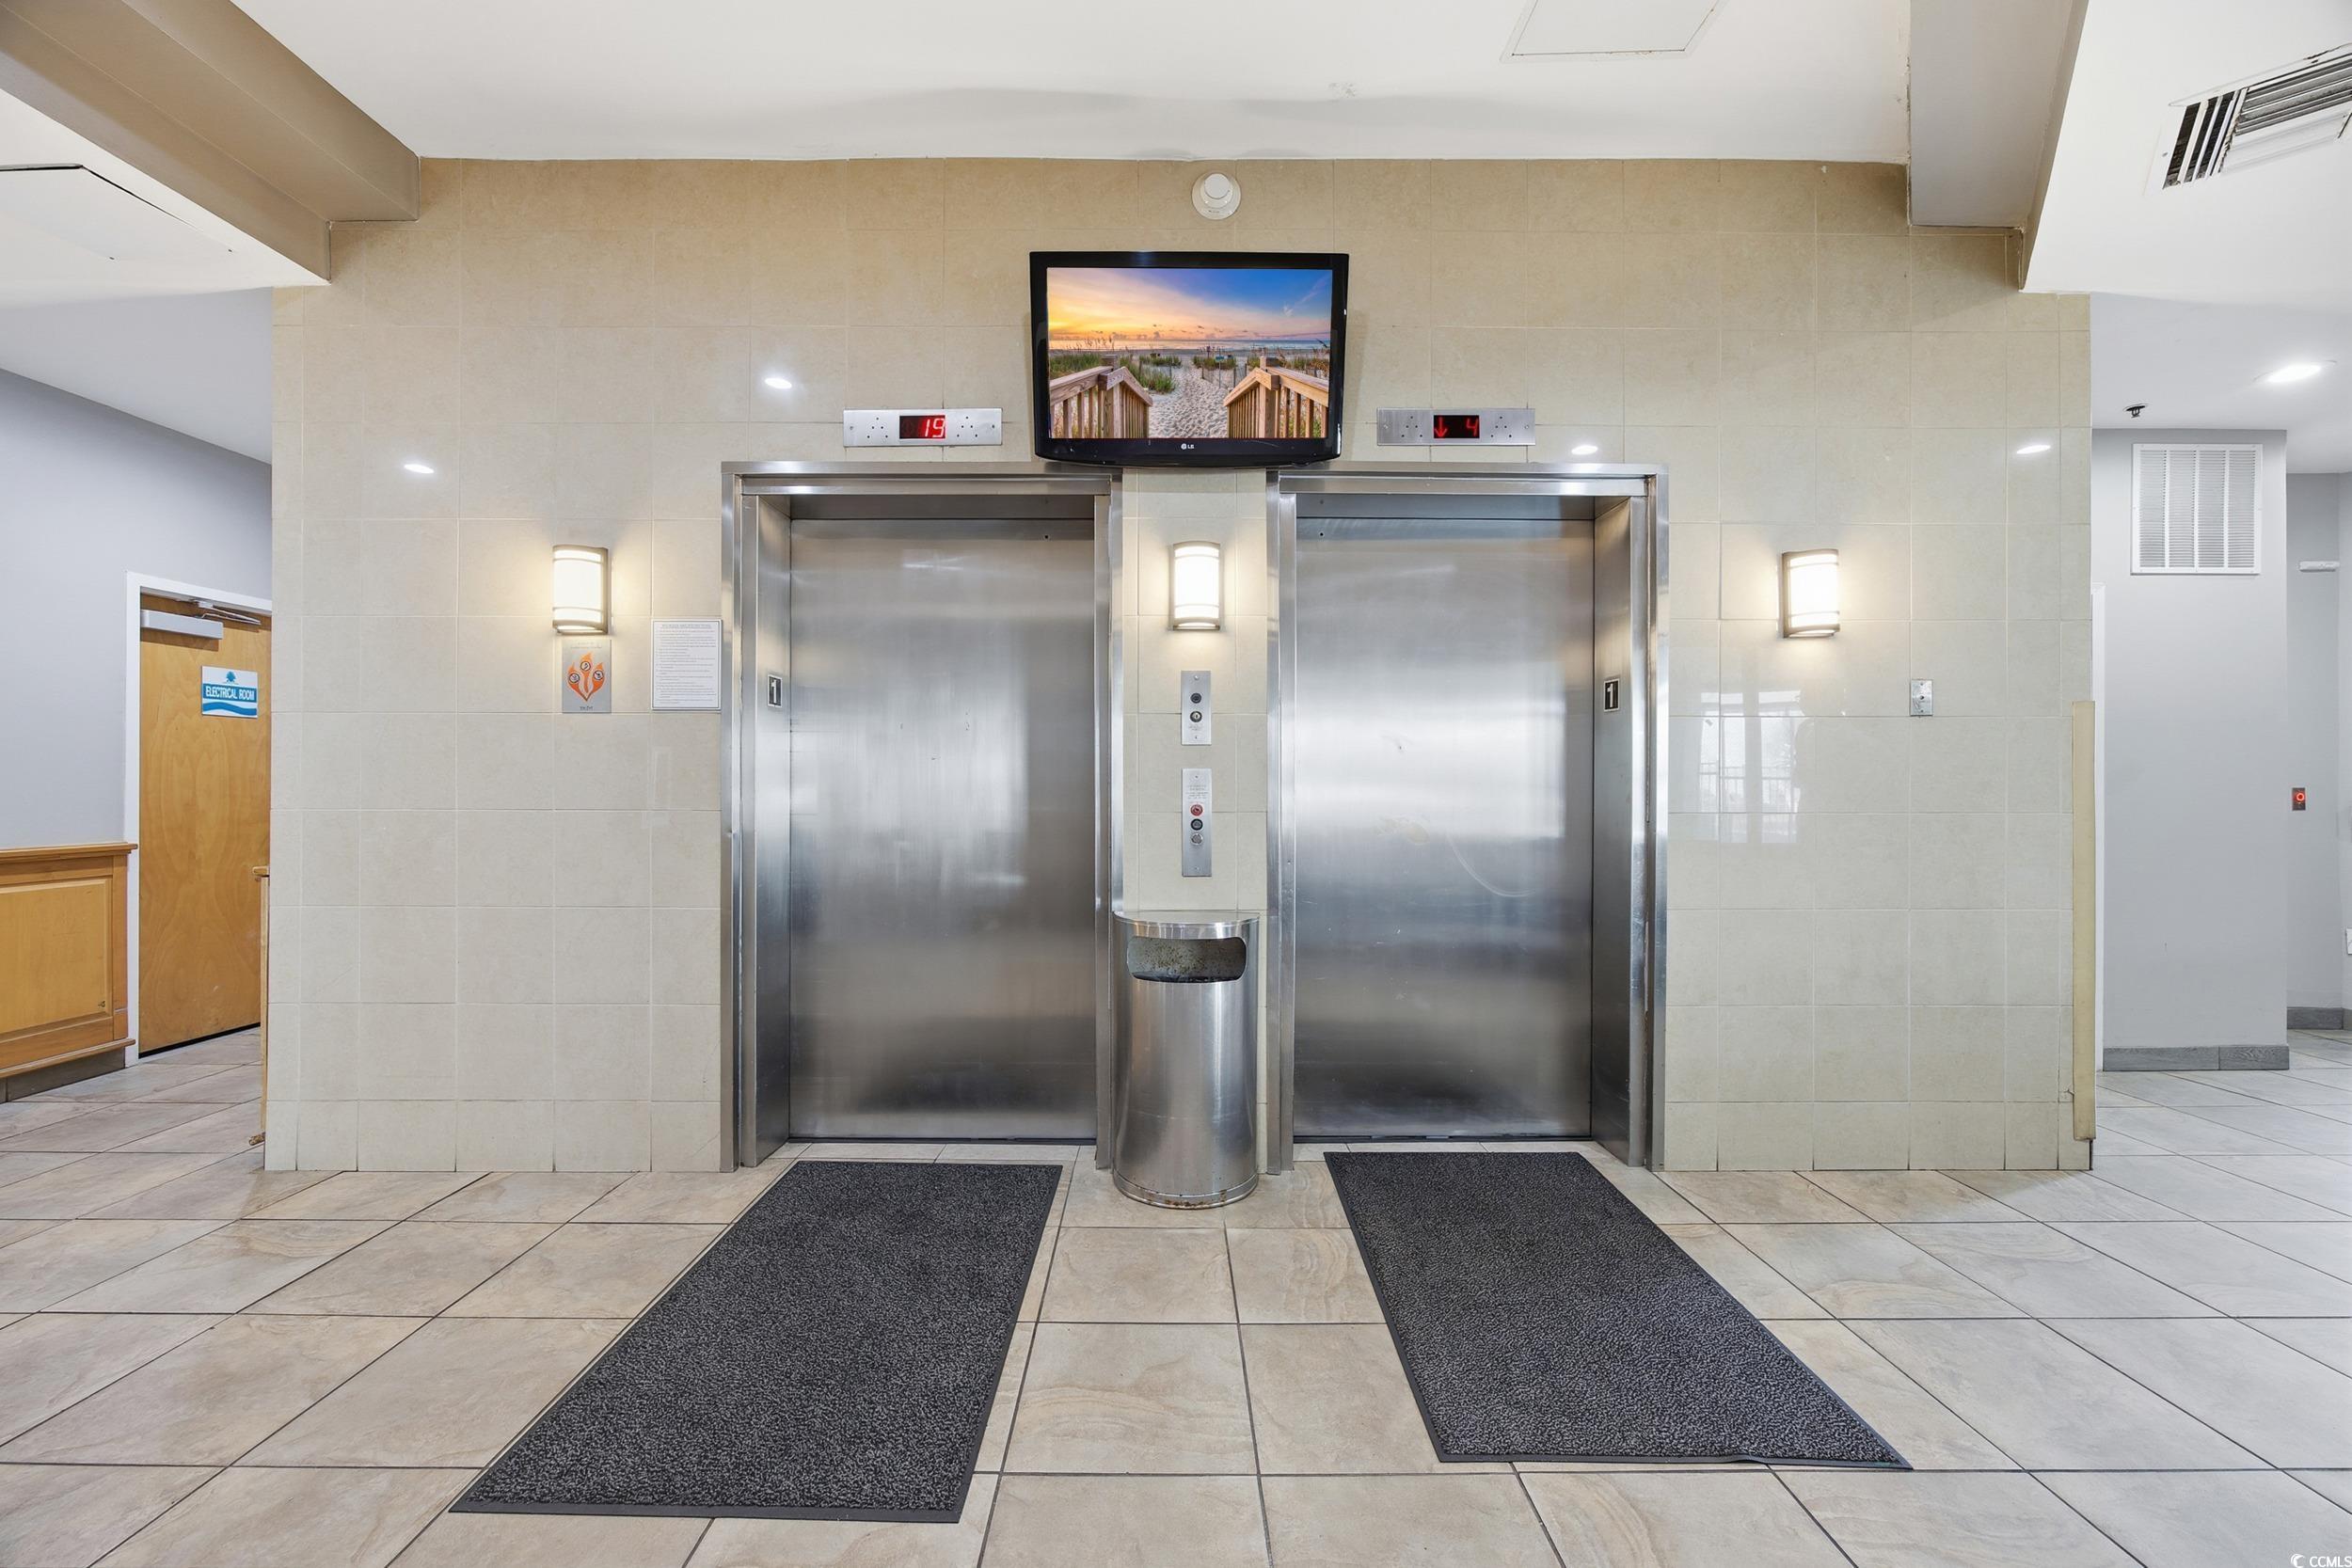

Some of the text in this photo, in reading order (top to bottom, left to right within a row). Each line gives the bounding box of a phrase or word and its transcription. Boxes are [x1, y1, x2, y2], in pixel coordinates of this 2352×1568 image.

[924, 418, 946, 437] 19
[1466, 418, 1479, 436] 4
[205, 686, 255, 701] ELECTRICAL ROOM
[771, 678, 777, 704] 1
[1607, 683, 1613, 707] 1
